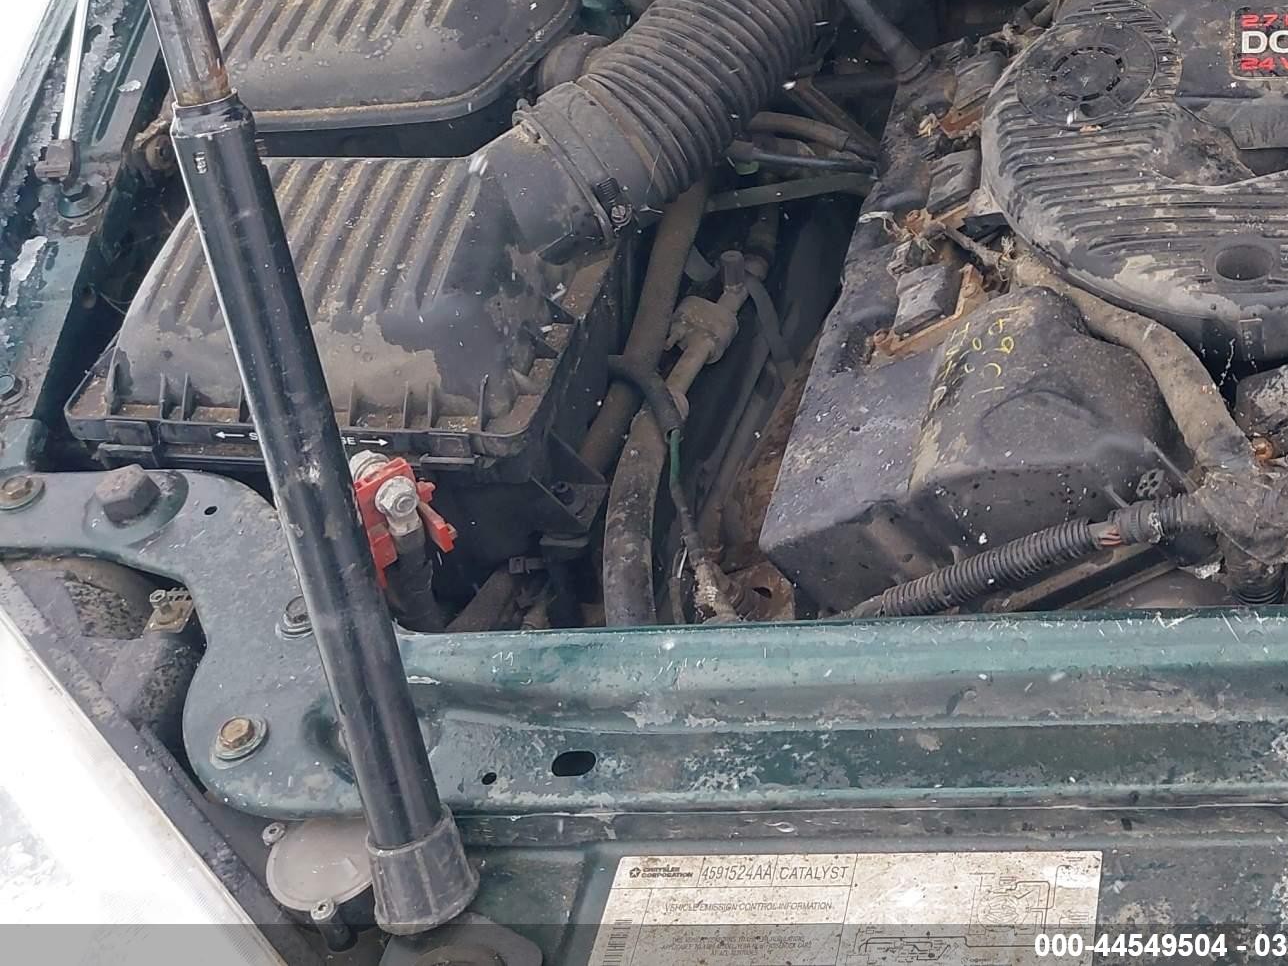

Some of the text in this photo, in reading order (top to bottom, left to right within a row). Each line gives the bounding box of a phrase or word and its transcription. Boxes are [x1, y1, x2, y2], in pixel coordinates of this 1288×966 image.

[1242, 14, 1279, 27] 2.7
[1240, 57, 1275, 70] 24
[702, 865, 772, 881] 4591524AA
[780, 866, 849, 880] CATALYST
[779, 901, 832, 911] INFORMATION
